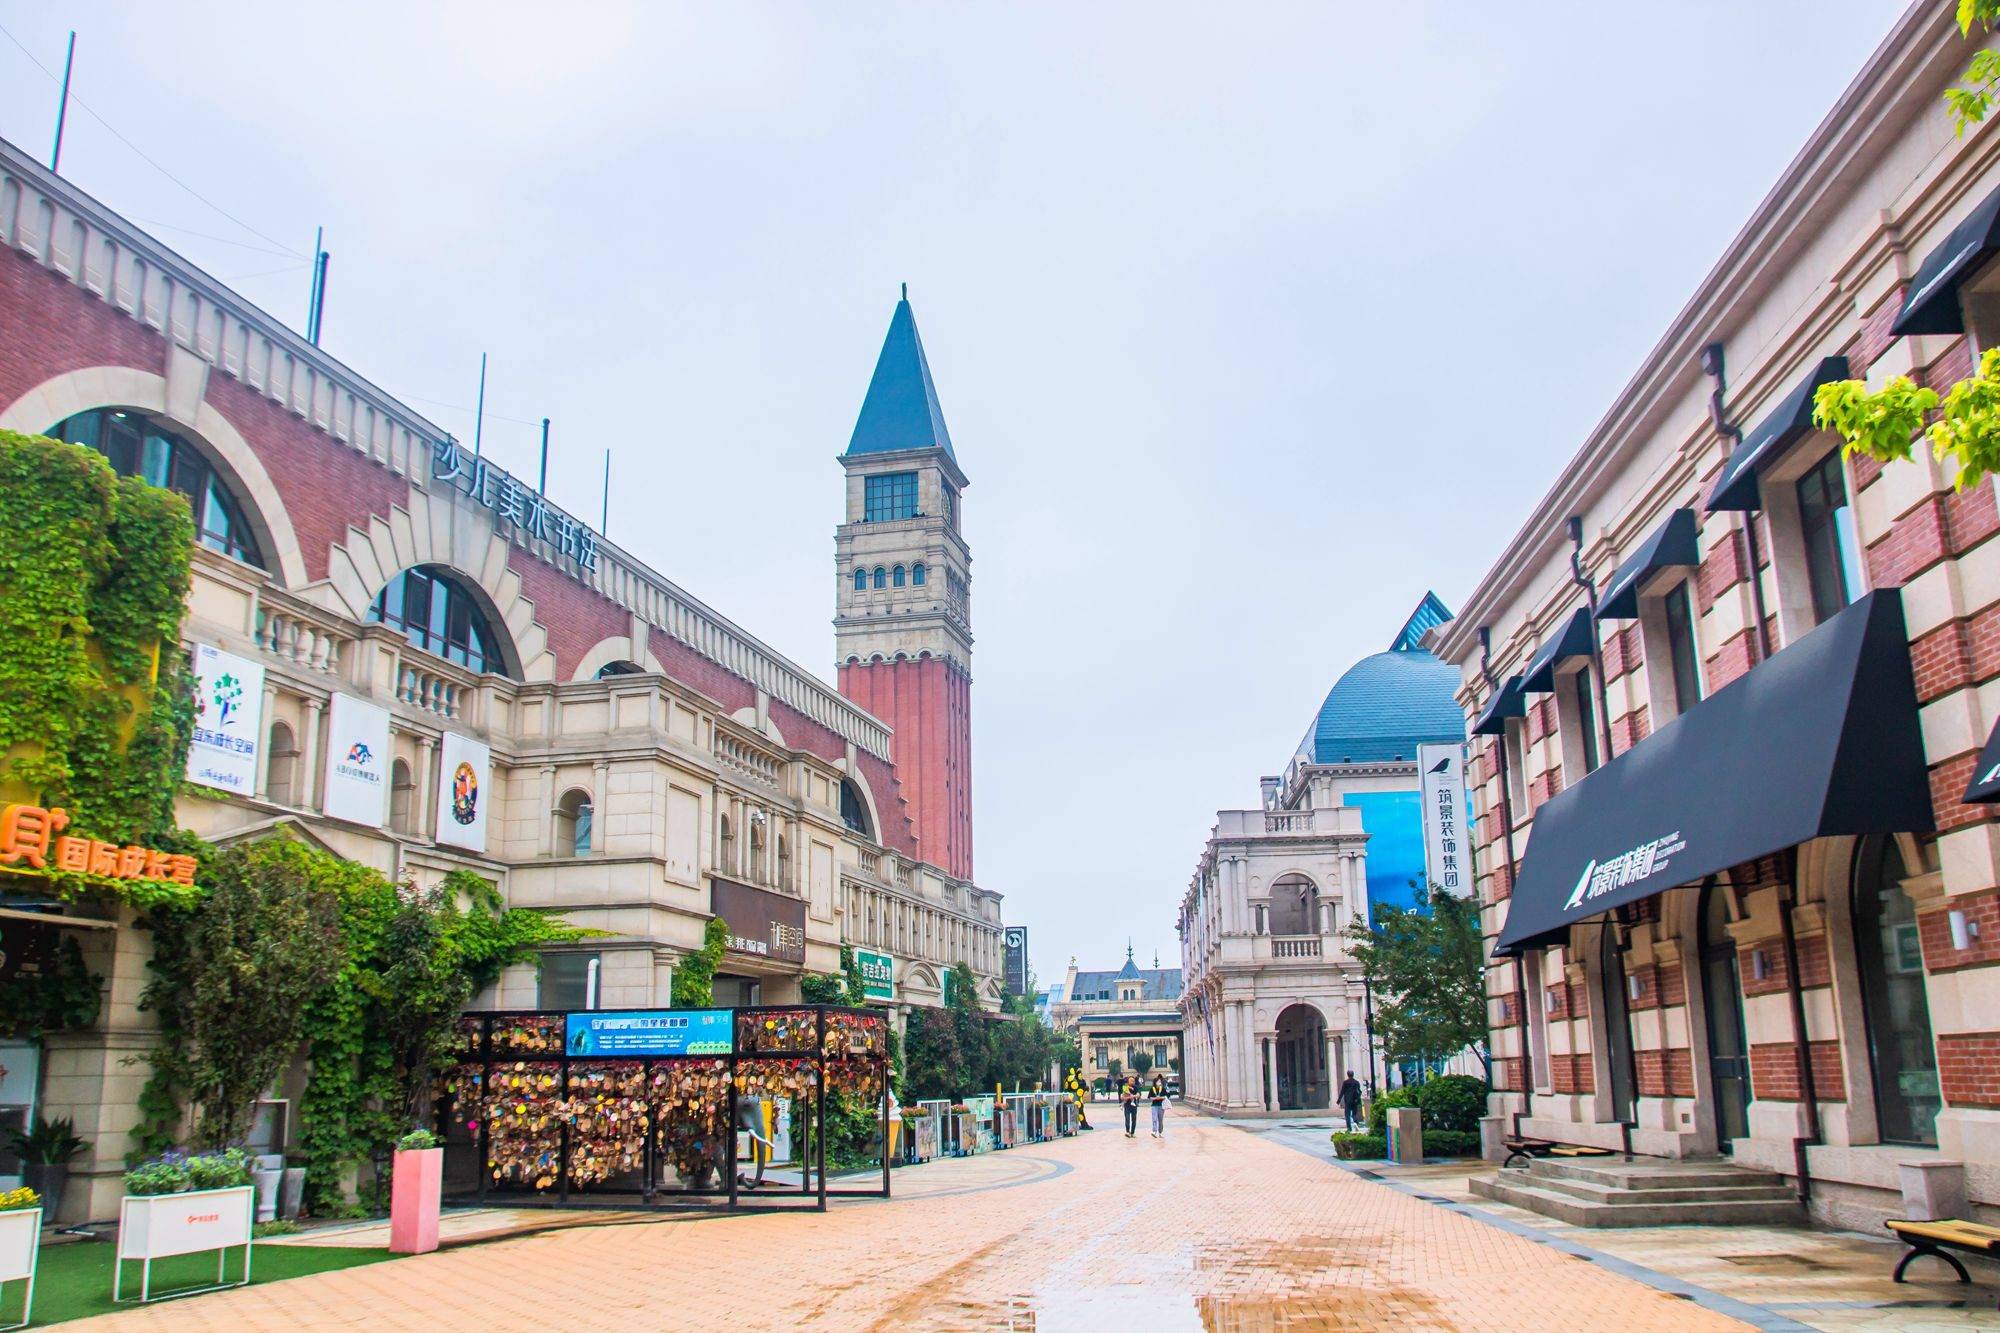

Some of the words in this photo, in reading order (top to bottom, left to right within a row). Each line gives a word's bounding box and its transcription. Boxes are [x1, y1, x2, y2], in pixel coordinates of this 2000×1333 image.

[436, 442, 597, 573] 少儿美术书法
[56, 836, 198, 888] 国际成长营
[1437, 788, 1459, 888] 筑景装饰集团
[1587, 840, 1659, 900] 筑景装饰集团
